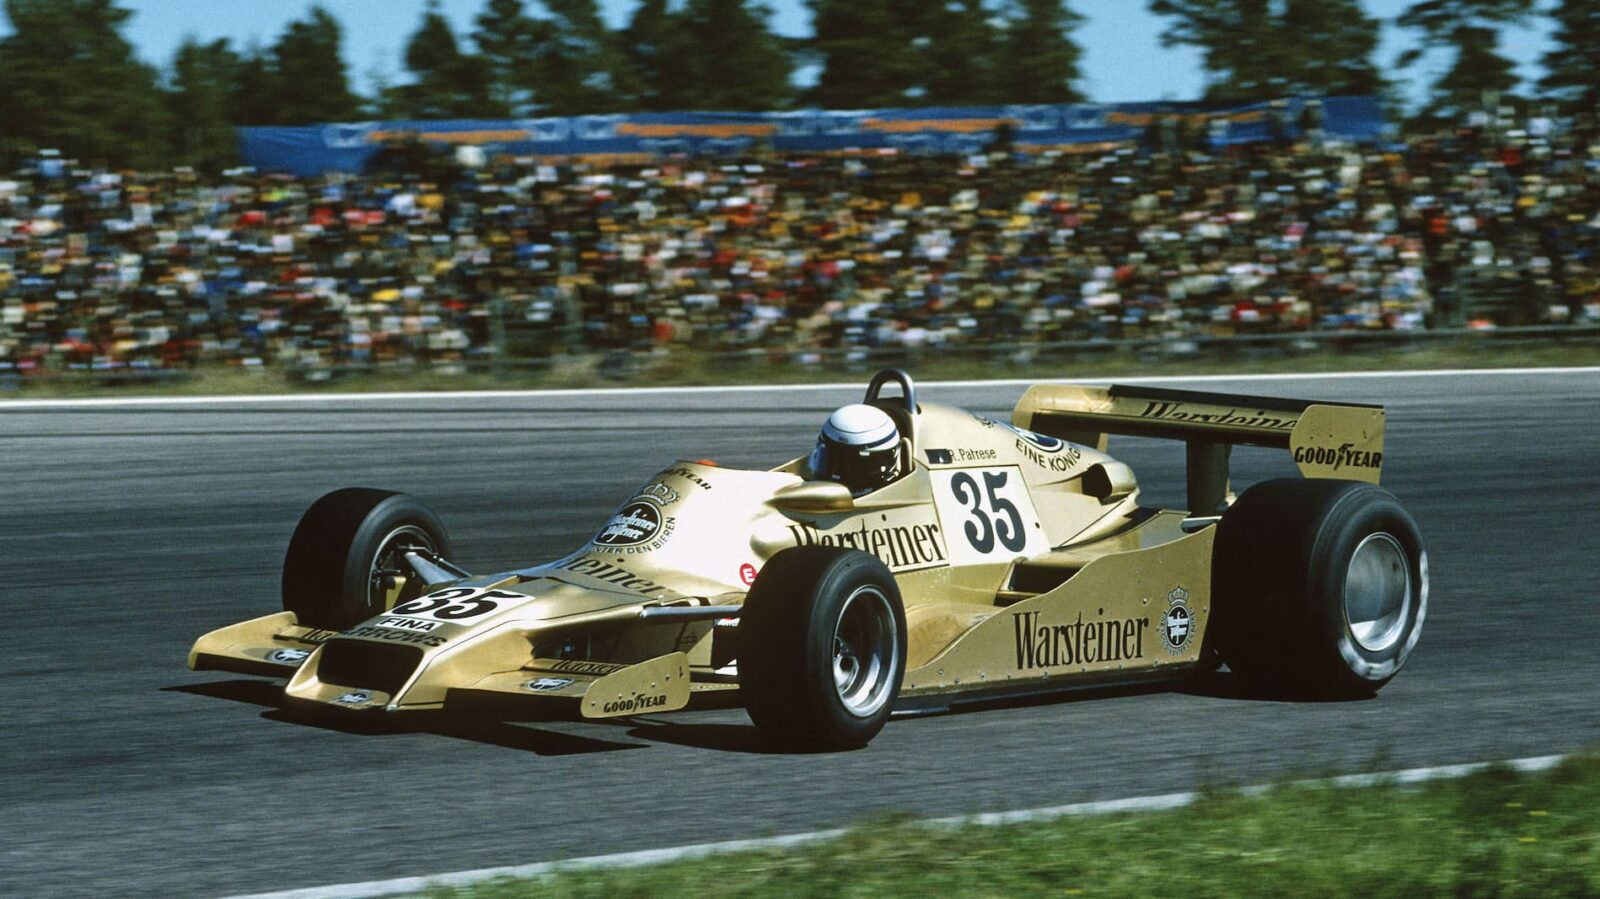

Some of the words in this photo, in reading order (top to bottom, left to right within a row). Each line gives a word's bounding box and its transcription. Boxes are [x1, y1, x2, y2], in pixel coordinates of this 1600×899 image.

[1141, 401, 1298, 428] Warsteine
[959, 448, 997, 461] Patrese
[1016, 438, 1047, 469] EINE
[1295, 443, 1382, 471] GOODYEAR
[950, 472, 1026, 554] 35
[652, 516, 676, 549] BIEREN
[391, 588, 527, 620] 35
[380, 617, 435, 631] FINA
[1012, 608, 1149, 670] Warsteiner
[603, 693, 667, 713] GOODYEAR
